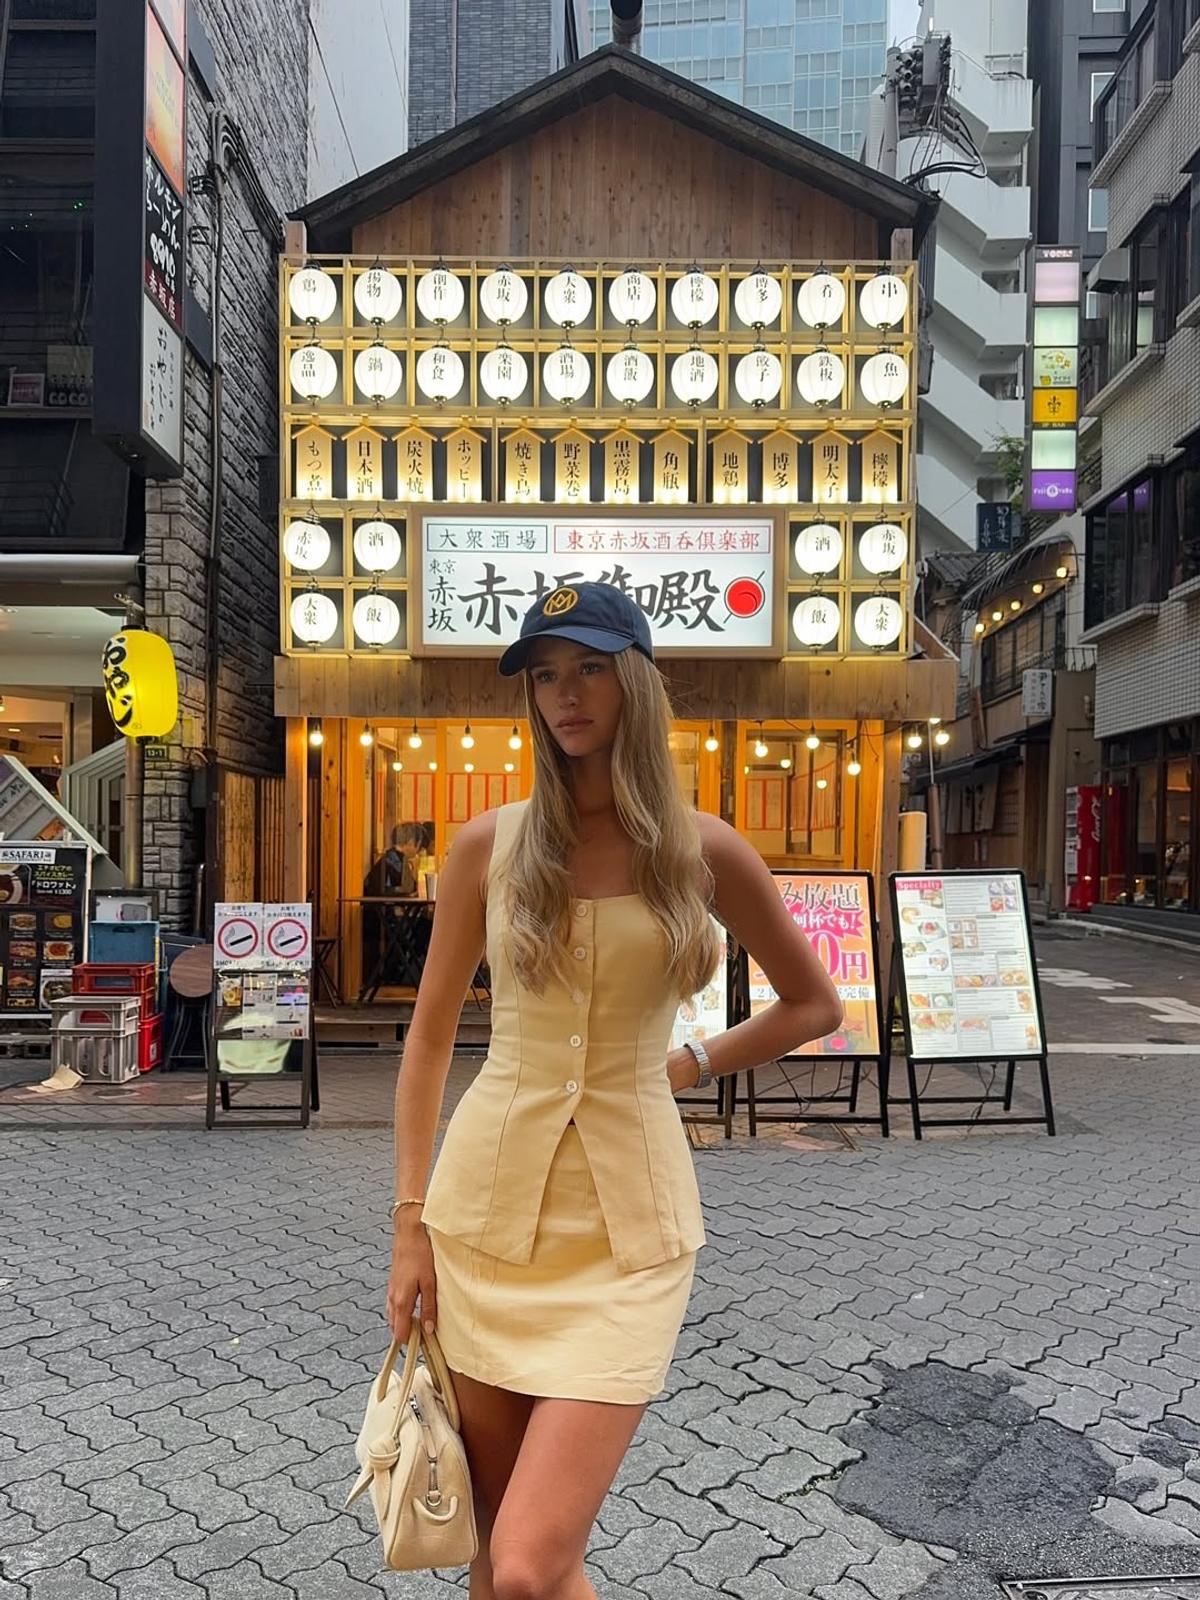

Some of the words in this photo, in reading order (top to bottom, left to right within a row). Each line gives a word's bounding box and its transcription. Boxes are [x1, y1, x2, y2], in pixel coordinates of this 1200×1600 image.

[433, 274, 447, 300] 創作
[497, 275, 511, 302] 赤坂
[627, 275, 641, 300] 商店
[756, 277, 769, 303] 博多
[882, 281, 898, 298] 串
[432, 352, 446, 381] 和食
[560, 352, 574, 379] 酒場
[307, 441, 322, 491] もつ煮
[357, 441, 373, 494] 日本酒
[407, 440, 423, 495] 炭火焼
[515, 442, 531, 496] 焼き鳥
[614, 440, 631, 496] 黒霧島
[663, 451, 680, 490] 角瓶
[722, 452, 739, 488] 地鶏
[773, 452, 790, 489] 博多
[823, 445, 839, 498] 明太子
[296, 528, 312, 560] 赤坂
[368, 531, 384, 547] 酒
[439, 528, 537, 549] 大衆酒場
[815, 535, 830, 551] 酒
[882, 528, 896, 555] 赤坂
[428, 558, 457, 574] 東京
[303, 597, 318, 625] 大衆
[366, 607, 382, 622] 飯
[428, 575, 458, 633] 赤坂
[811, 609, 826, 624] 飯
[875, 603, 889, 631] 大衆
[102, 637, 133, 728] おやじ
[9, 850, 44, 859] SAFARI
[898, 880, 941, 890] Specialty
